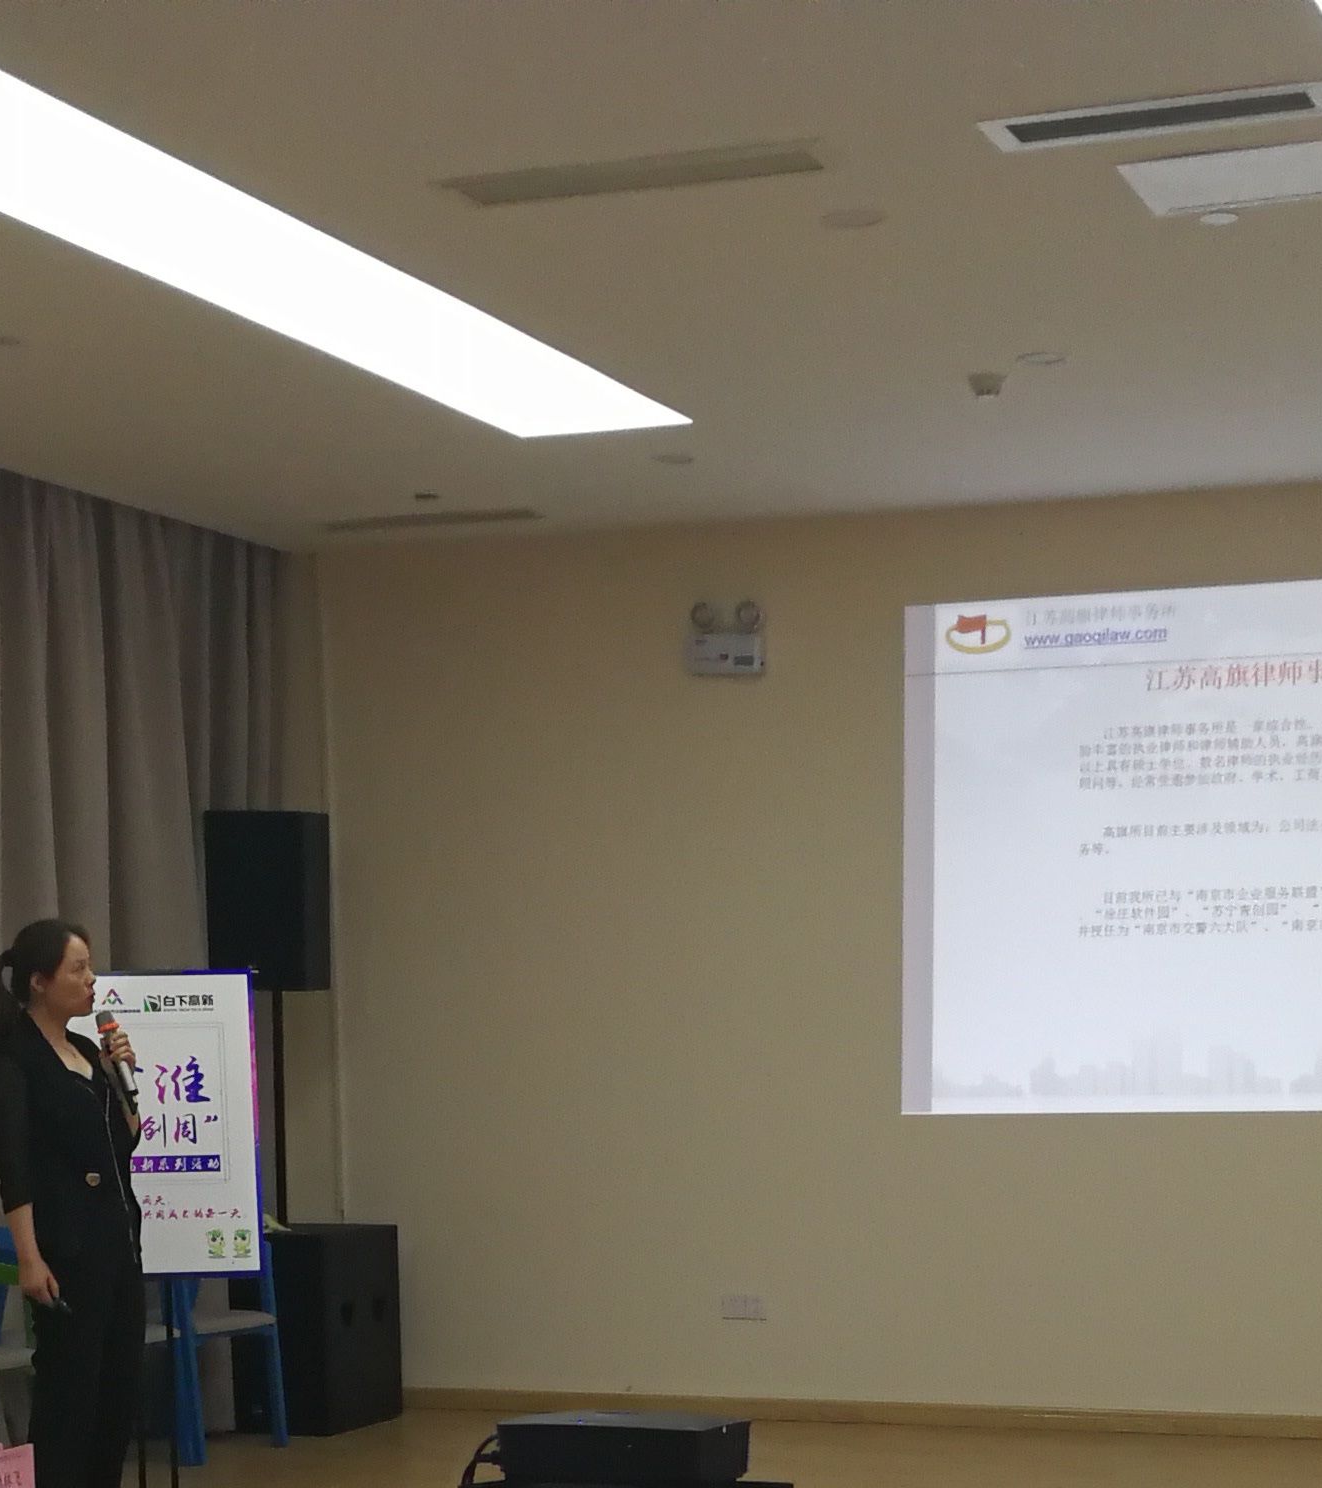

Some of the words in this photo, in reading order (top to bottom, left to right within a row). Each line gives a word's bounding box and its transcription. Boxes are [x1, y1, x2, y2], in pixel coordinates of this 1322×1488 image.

[163, 994, 214, 1008] 白下高新
[134, 1056, 211, 1104] 淮
